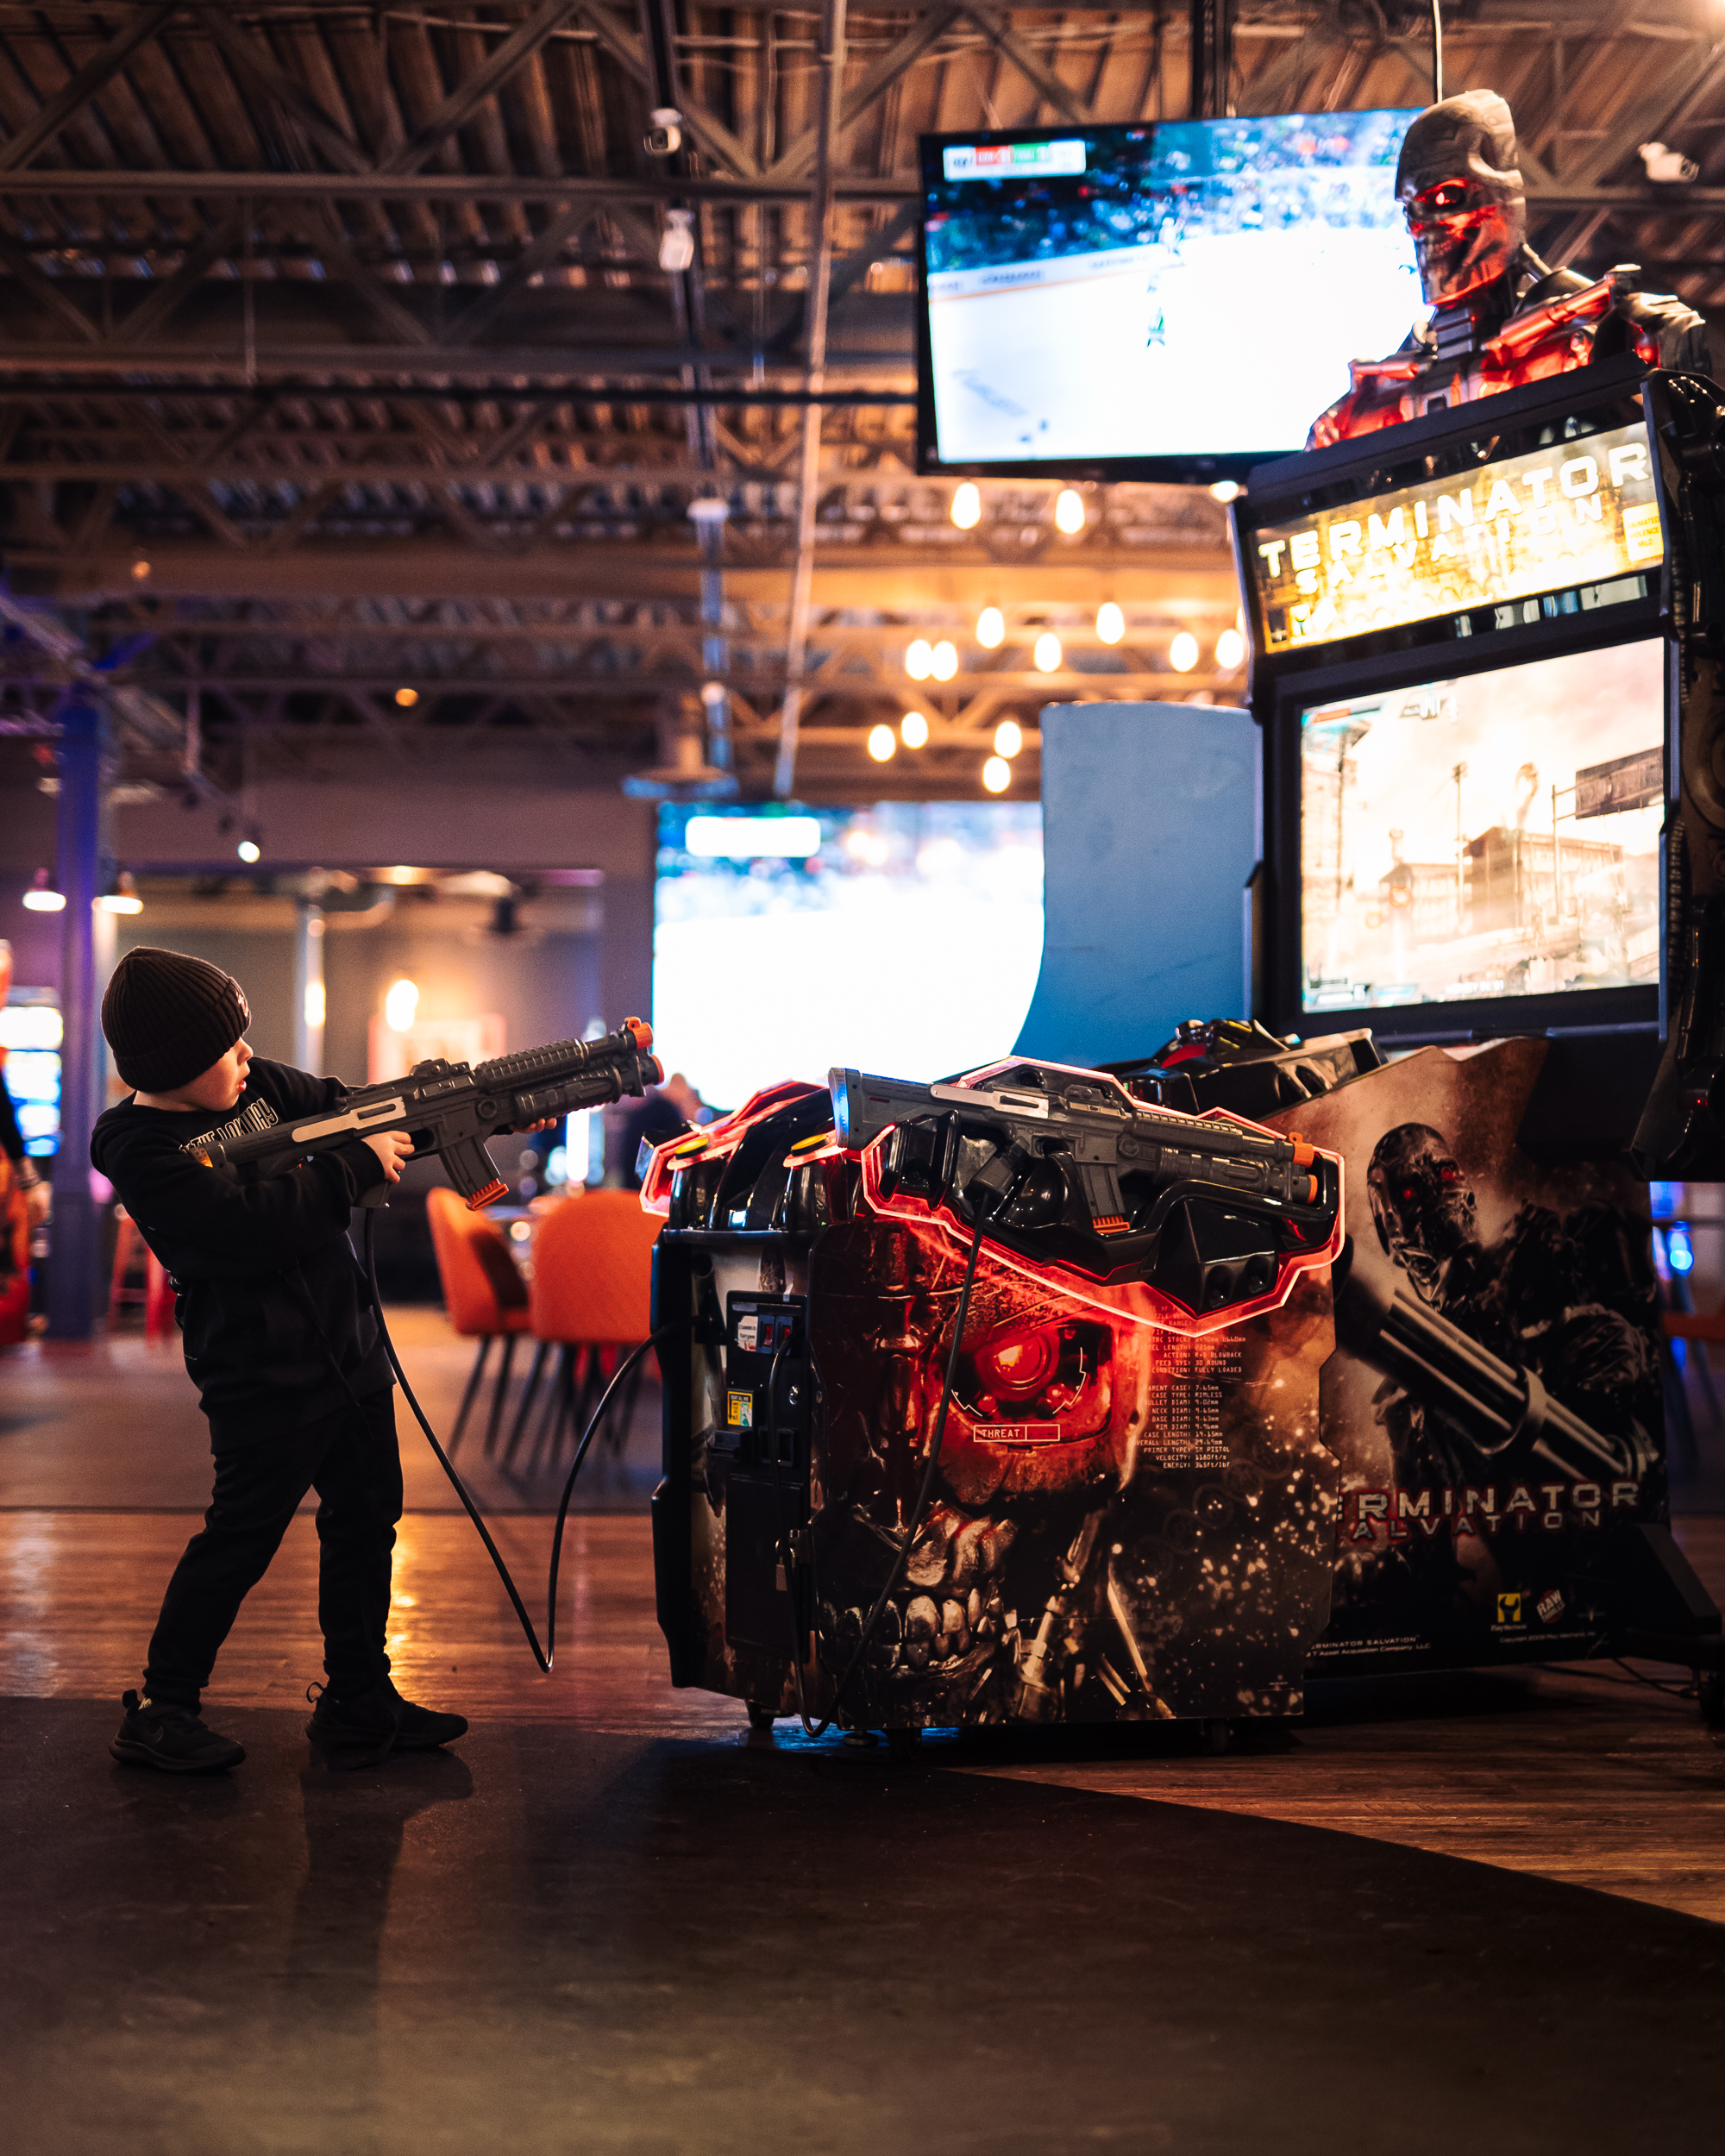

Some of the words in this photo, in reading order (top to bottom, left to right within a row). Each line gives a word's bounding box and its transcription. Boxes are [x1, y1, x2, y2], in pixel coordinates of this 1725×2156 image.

[1258, 442, 1648, 578] TERMINATOR
[1295, 494, 1603, 595] SALVATION
[982, 1429, 1019, 1438] THREAT
[1338, 1482, 1639, 1521] RMINATOR
[1537, 1589, 1561, 1616] RAW
[1367, 1637, 1416, 1645] SALVATION
